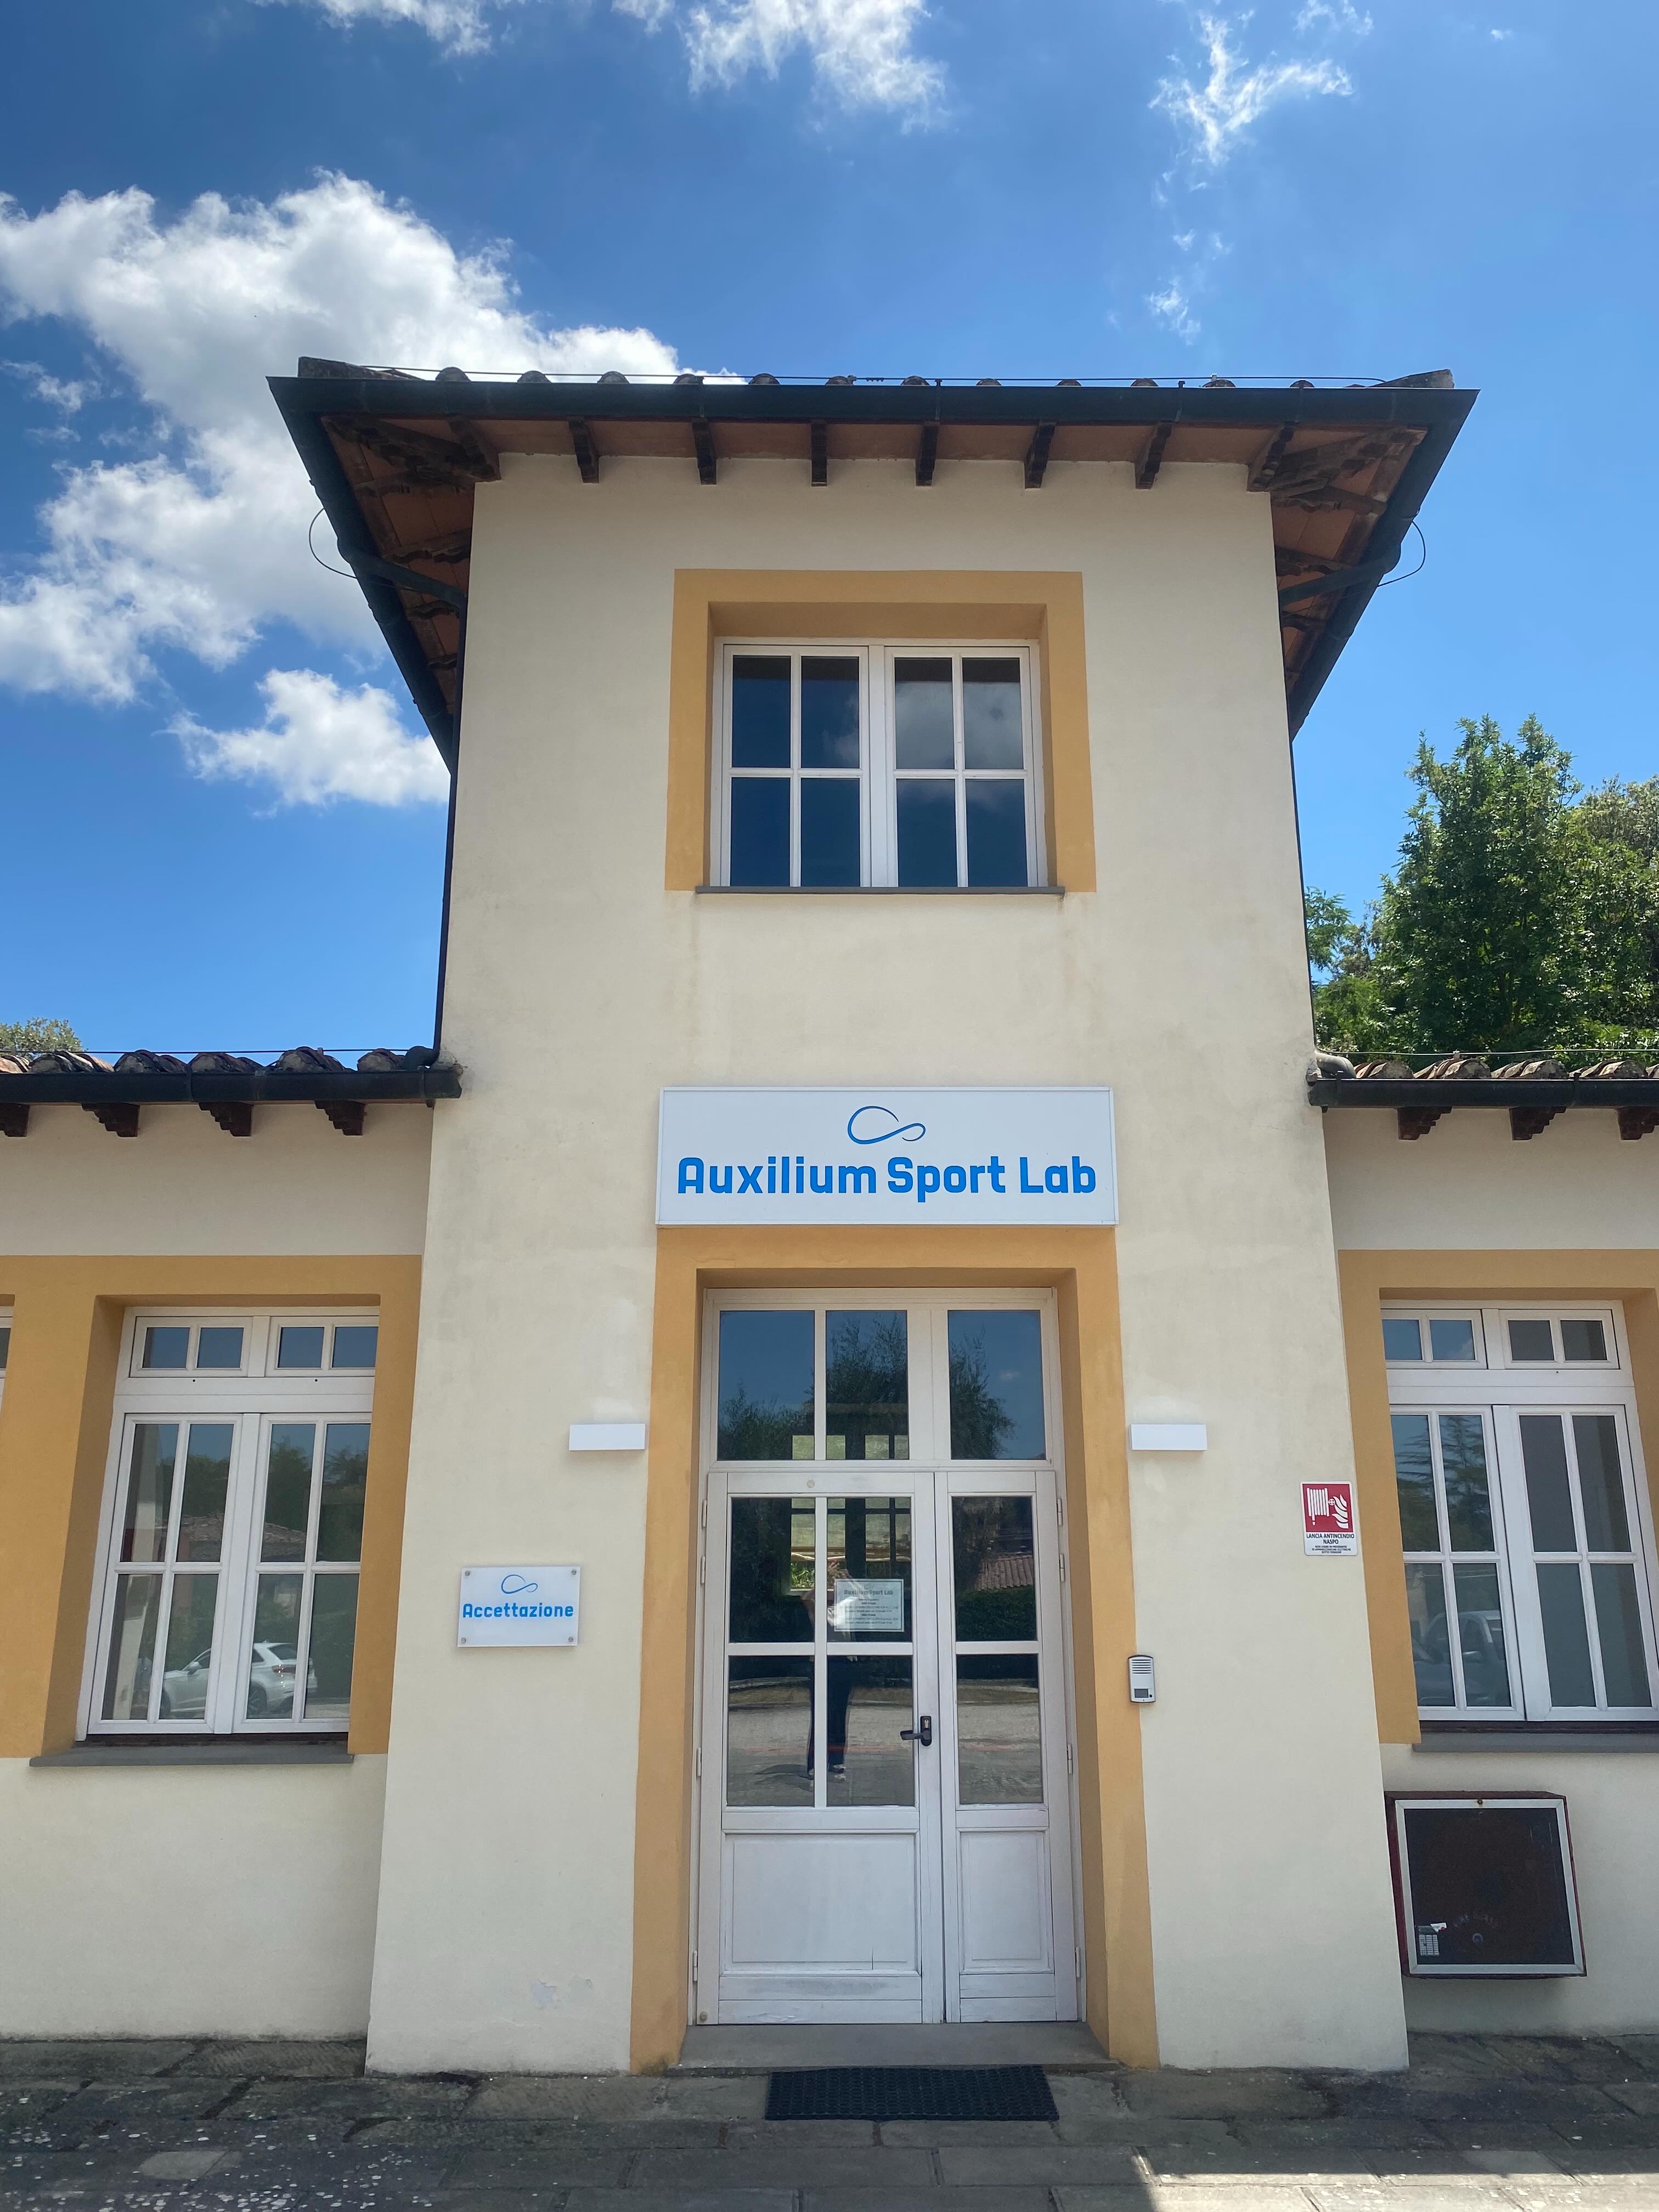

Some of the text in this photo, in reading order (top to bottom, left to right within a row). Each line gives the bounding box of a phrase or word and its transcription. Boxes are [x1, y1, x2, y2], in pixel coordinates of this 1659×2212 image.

[678, 1155, 1096, 1203] Auxilium Sport Lab
[462, 1602, 573, 1618] Accettazione
